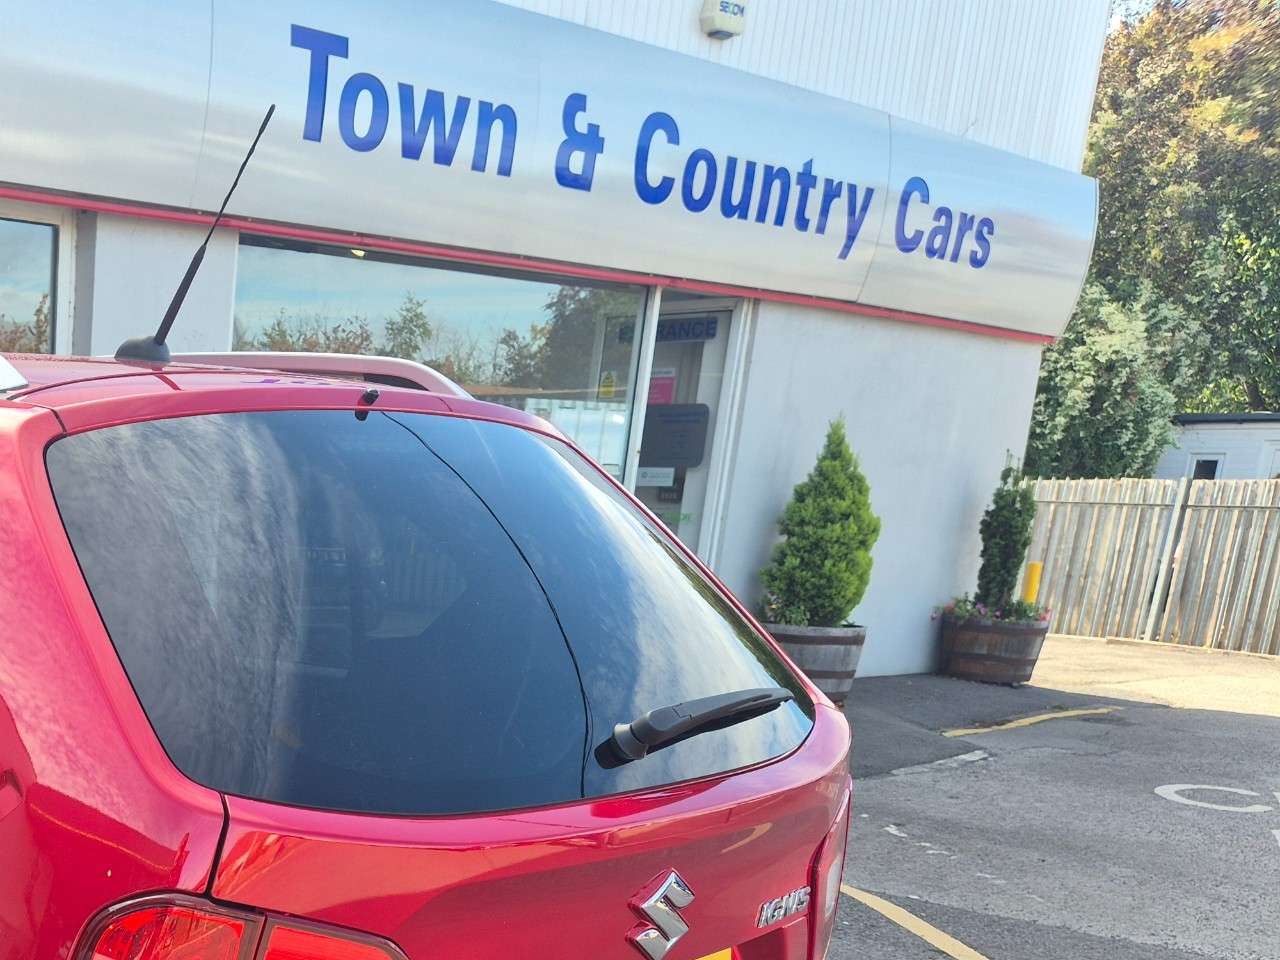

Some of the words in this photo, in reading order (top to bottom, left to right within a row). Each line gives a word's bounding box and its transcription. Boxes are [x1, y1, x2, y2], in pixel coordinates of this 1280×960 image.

[290, 24, 517, 177] Town
[555, 93, 605, 192] &
[634, 111, 874, 261] Country
[894, 177, 996, 269] Cars
